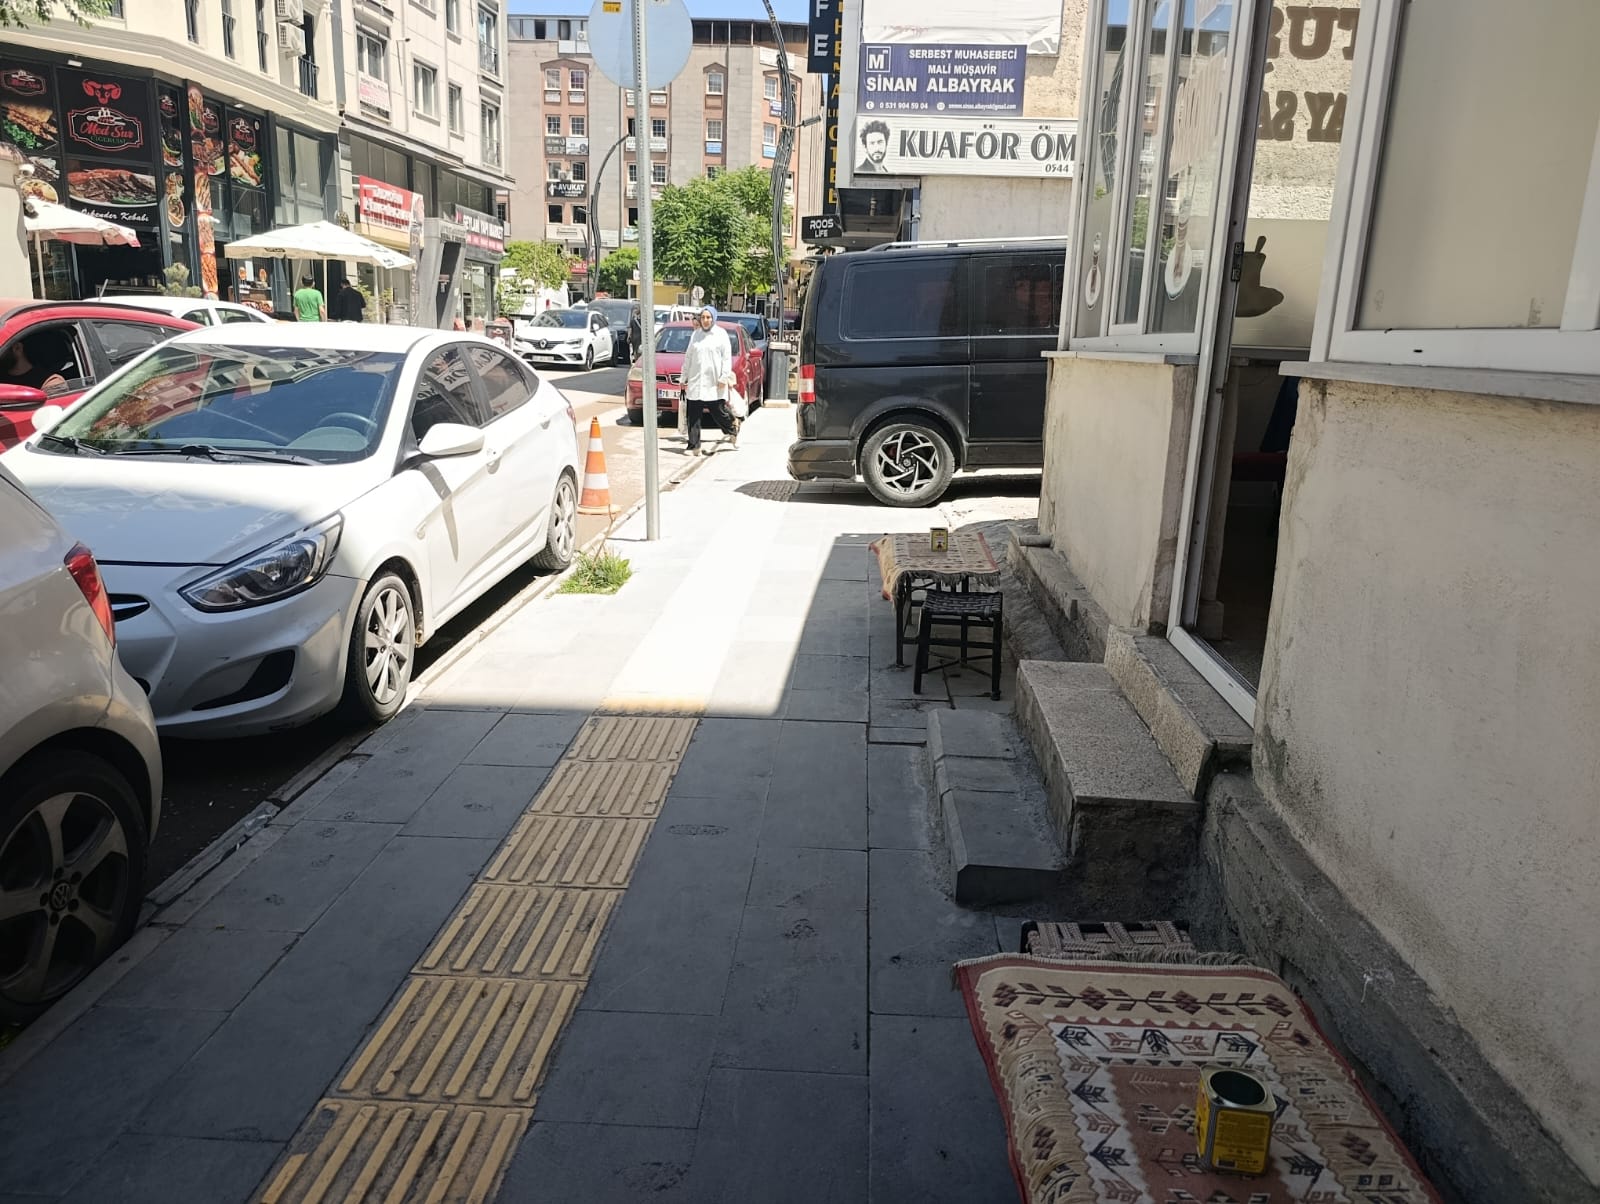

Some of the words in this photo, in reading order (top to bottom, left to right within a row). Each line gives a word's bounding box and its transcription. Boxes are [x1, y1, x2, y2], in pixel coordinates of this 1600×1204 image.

[909, 49, 952, 59] SERBEST
[954, 48, 1017, 60] MUHASEBECİ
[928, 63, 951, 74] MALİ
[954, 64, 997, 76] MÜŞAVİR
[866, 74, 917, 92] SİNAN
[926, 78, 1016, 93] ALBAYRAK
[80, 122, 110, 136] Med
[899, 124, 1021, 160] KUAFÖR
[809, 218, 834, 229] ROOS
